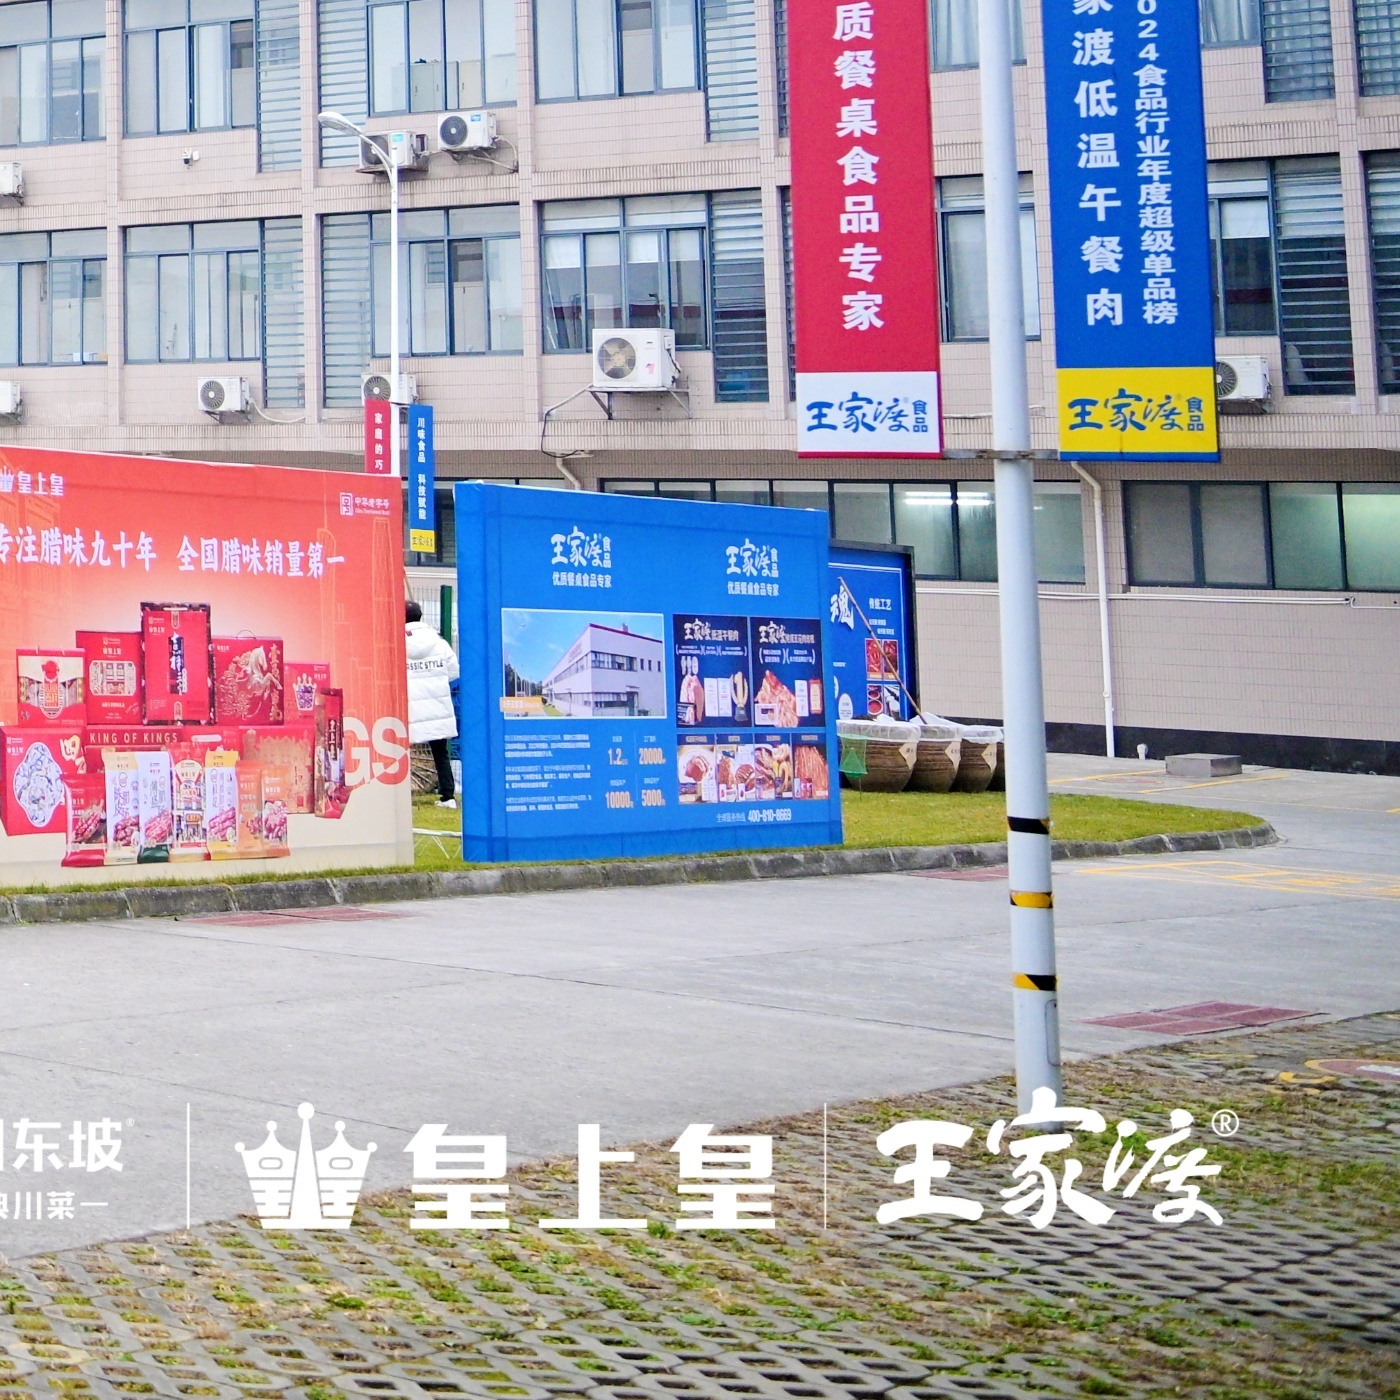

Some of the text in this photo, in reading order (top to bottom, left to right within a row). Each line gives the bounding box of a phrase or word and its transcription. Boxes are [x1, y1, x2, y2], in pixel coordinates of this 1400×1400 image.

[373, 412, 384, 473] 家庭的巧
[417, 417, 427, 463] 川味食品
[17, 471, 64, 496] 皇上皇
[175, 534, 347, 578] 全国腊味销量第一
[552, 571, 612, 588] 优质餐桌食品专家
[727, 581, 780, 597] 优质餐桌食品专家
[869, 597, 892, 611] 传统工艺
[425, 659, 444, 669] STYLE
[89, 732, 178, 745] KING OF KINGS
